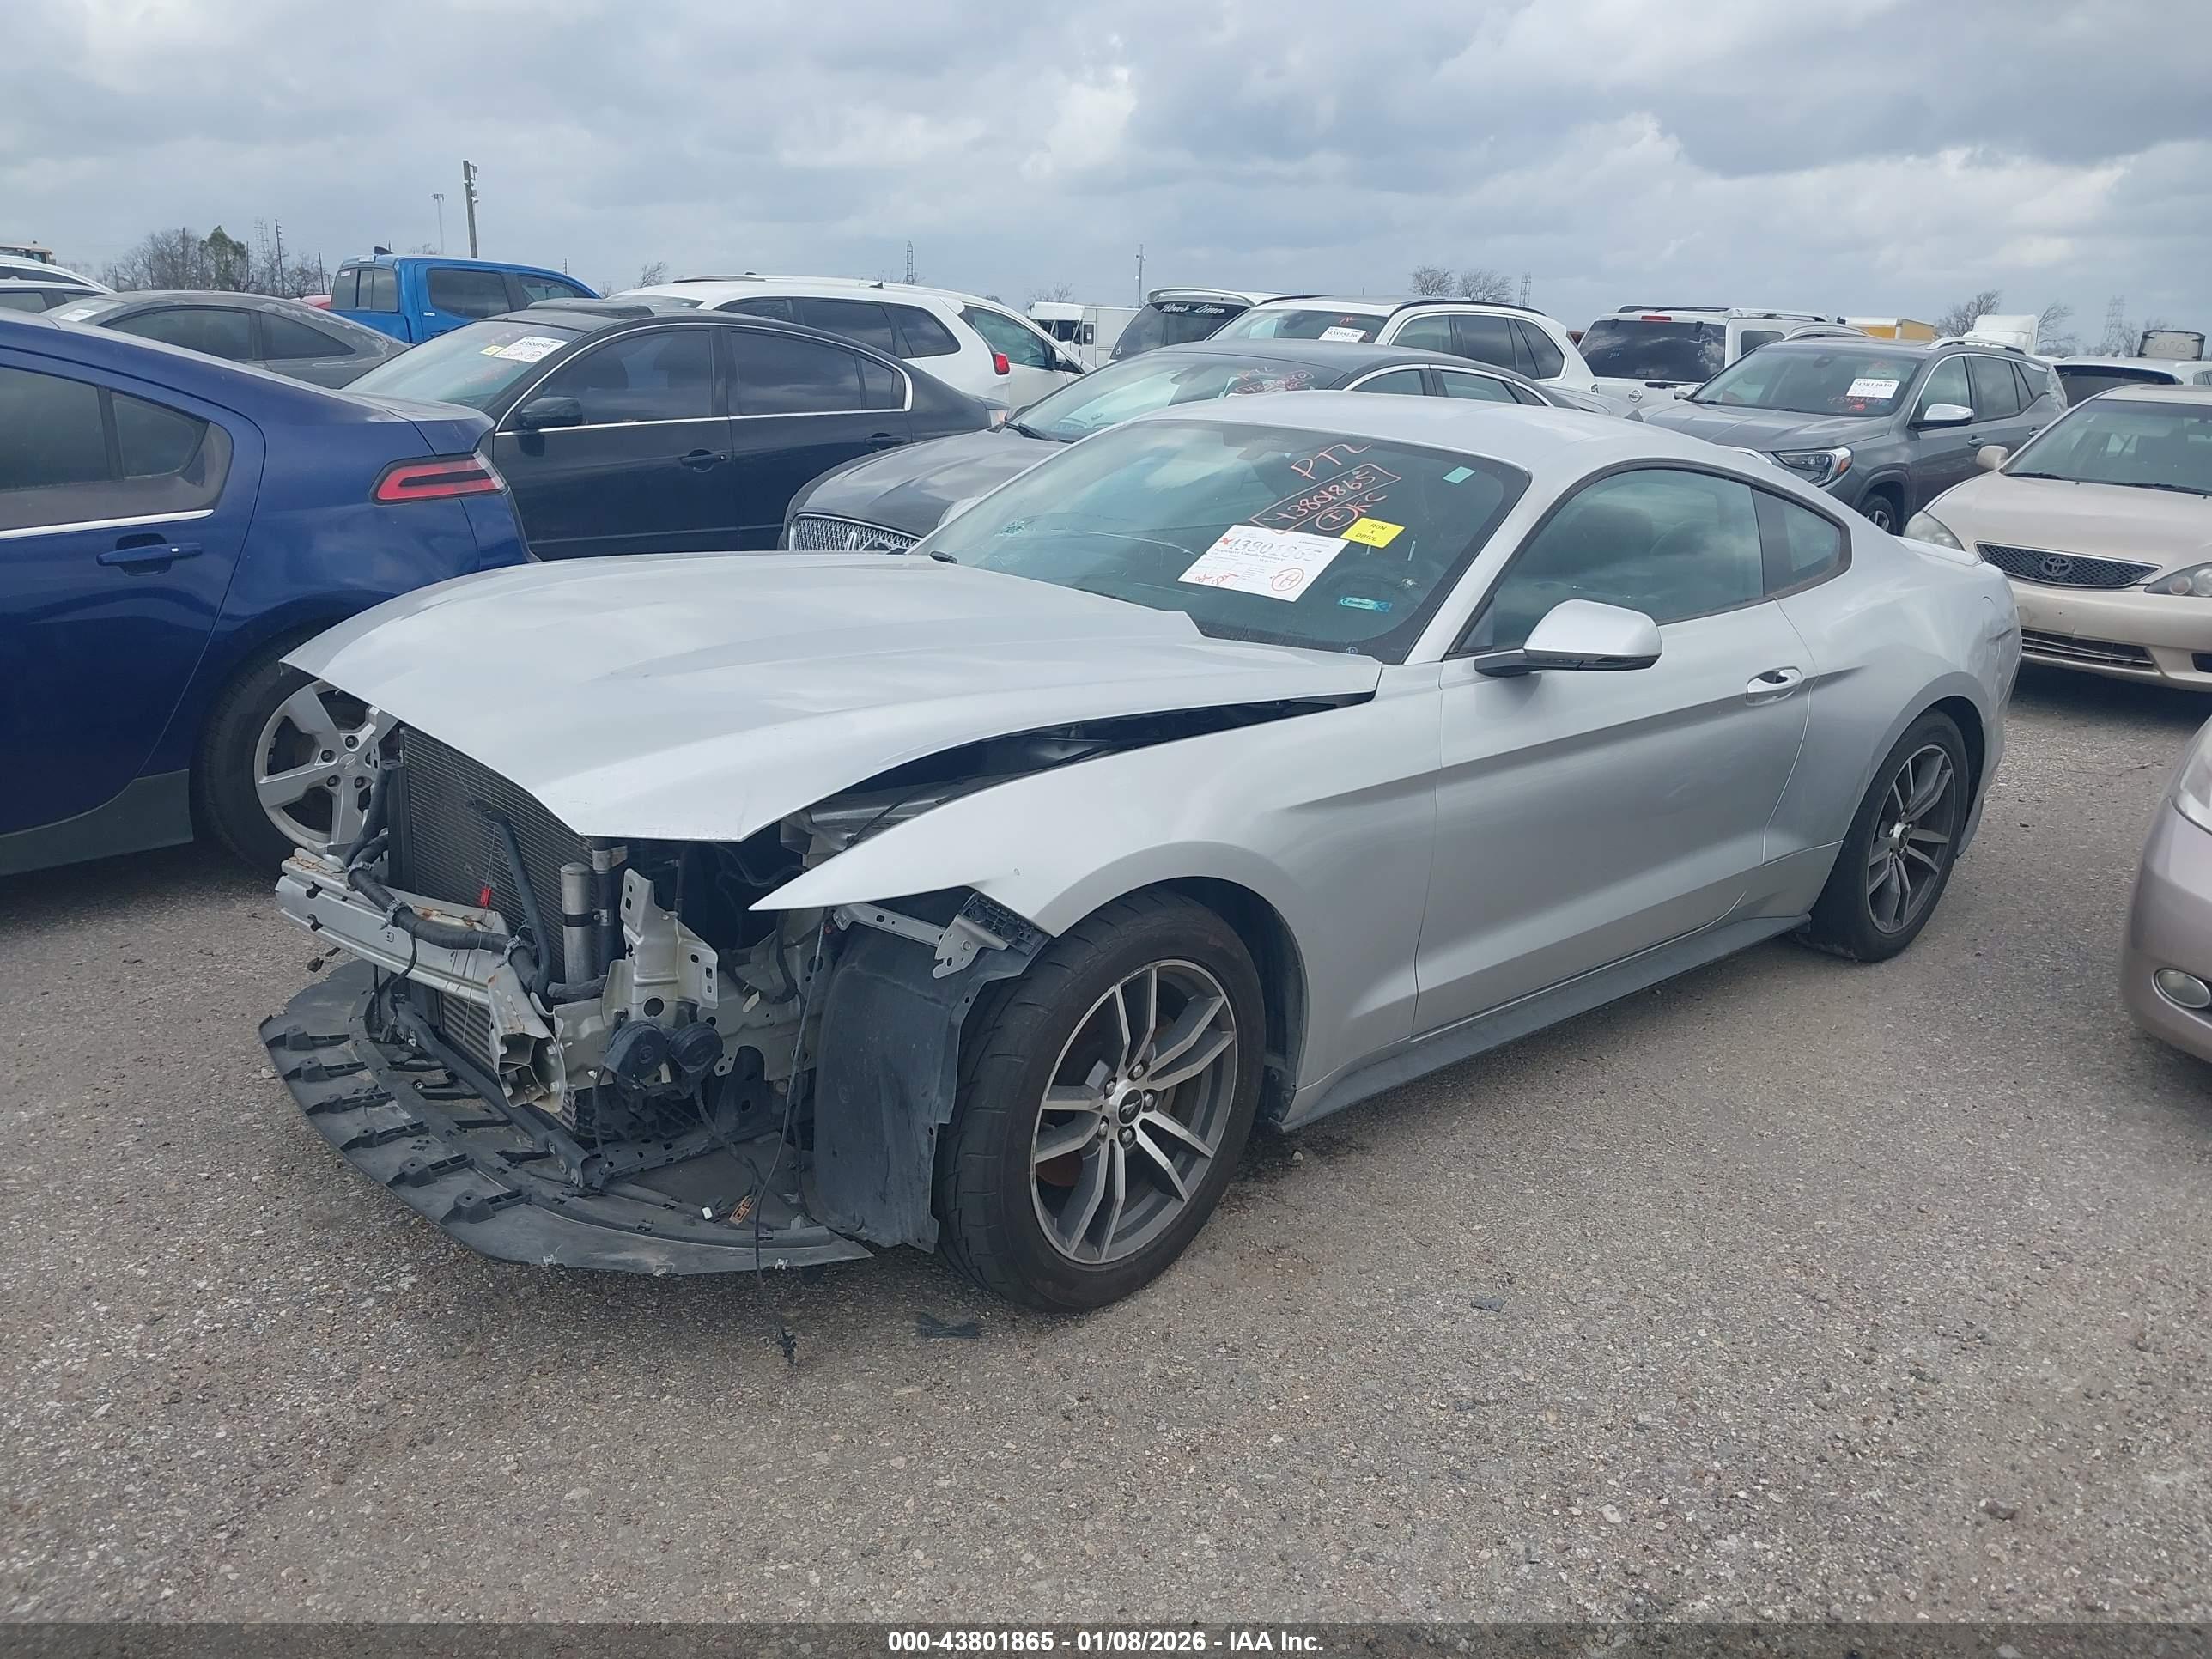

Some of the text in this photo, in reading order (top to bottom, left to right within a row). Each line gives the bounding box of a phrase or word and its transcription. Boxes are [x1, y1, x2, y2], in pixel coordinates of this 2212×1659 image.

[1193, 304, 1225, 314] Limo
[1262, 471, 1376, 520] 43801865
[1355, 532, 1379, 542] DRIVE
